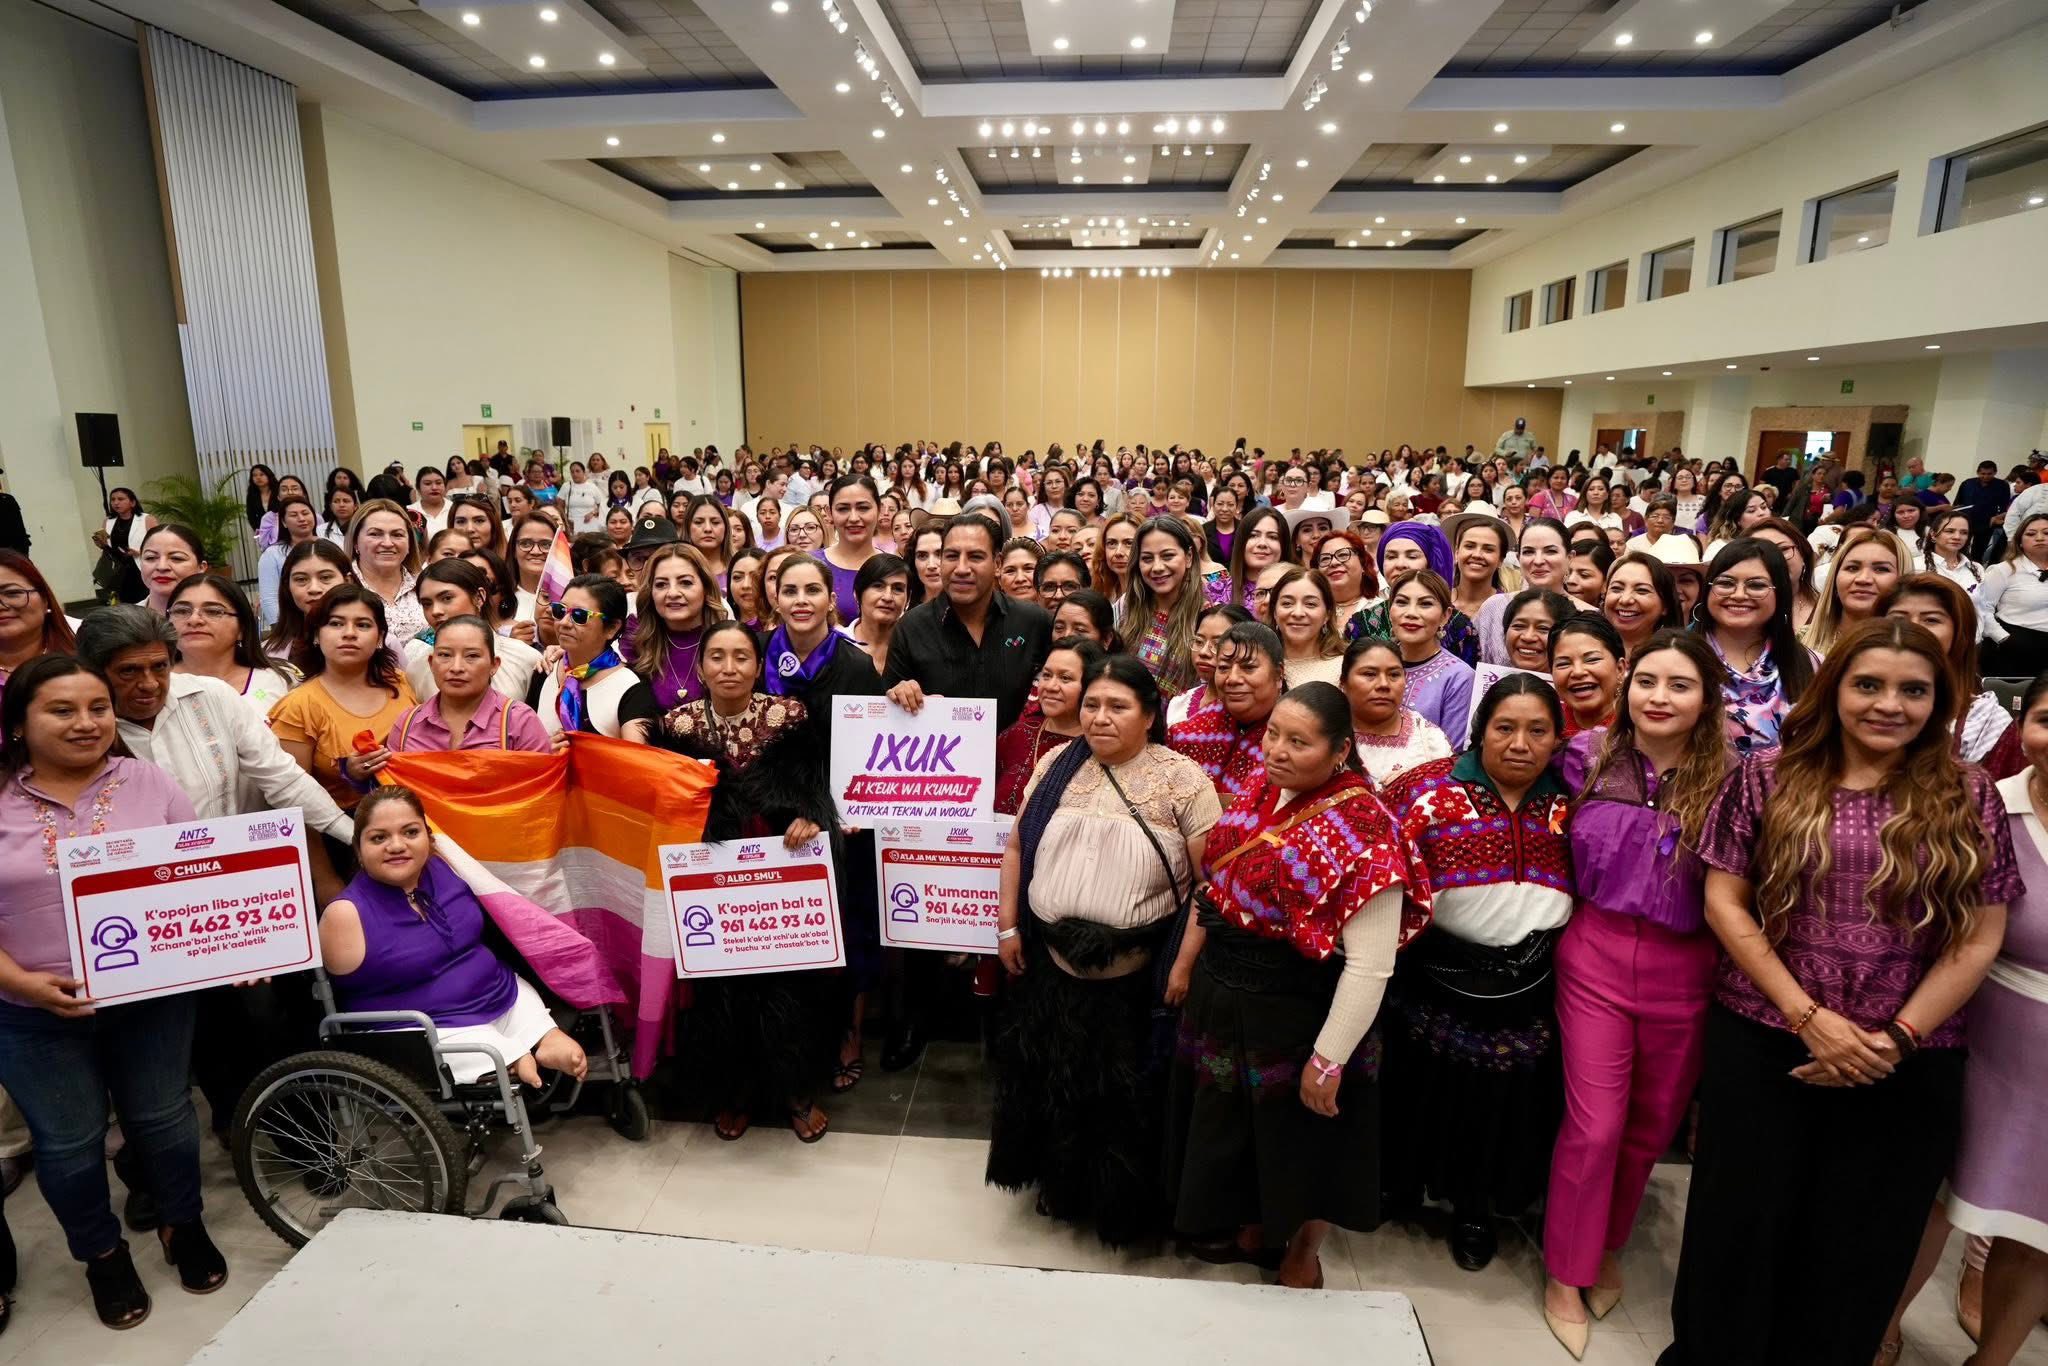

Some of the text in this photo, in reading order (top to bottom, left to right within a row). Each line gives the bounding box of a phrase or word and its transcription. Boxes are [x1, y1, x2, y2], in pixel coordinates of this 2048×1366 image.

[865, 732, 961, 772] IXUK
[852, 782, 864, 794] A'
[901, 783, 922, 796] WA
[892, 806, 923, 817] TEK'AN
[925, 807, 938, 816] JA
[178, 828, 208, 841] ANTS
[248, 822, 276, 832] ALERTA
[950, 827, 970, 836] IXUK
[740, 844, 760, 854] ANTS
[174, 860, 222, 876] CHUKA
[727, 872, 782, 884] ALBO SMU'L
[924, 884, 998, 900] K'umanan
[145, 888, 295, 921] K'opojan liba yajtalel
[718, 897, 822, 916] K'opojan bal ta
[926, 901, 1000, 918] 961 462 93
[148, 903, 297, 942] 961 462 93 40
[243, 926, 270, 937] winik
[272, 922, 298, 932] hora,
[720, 912, 826, 934] 961 462 93 40
[187, 936, 266, 958] sp'ejel k'aaletik
